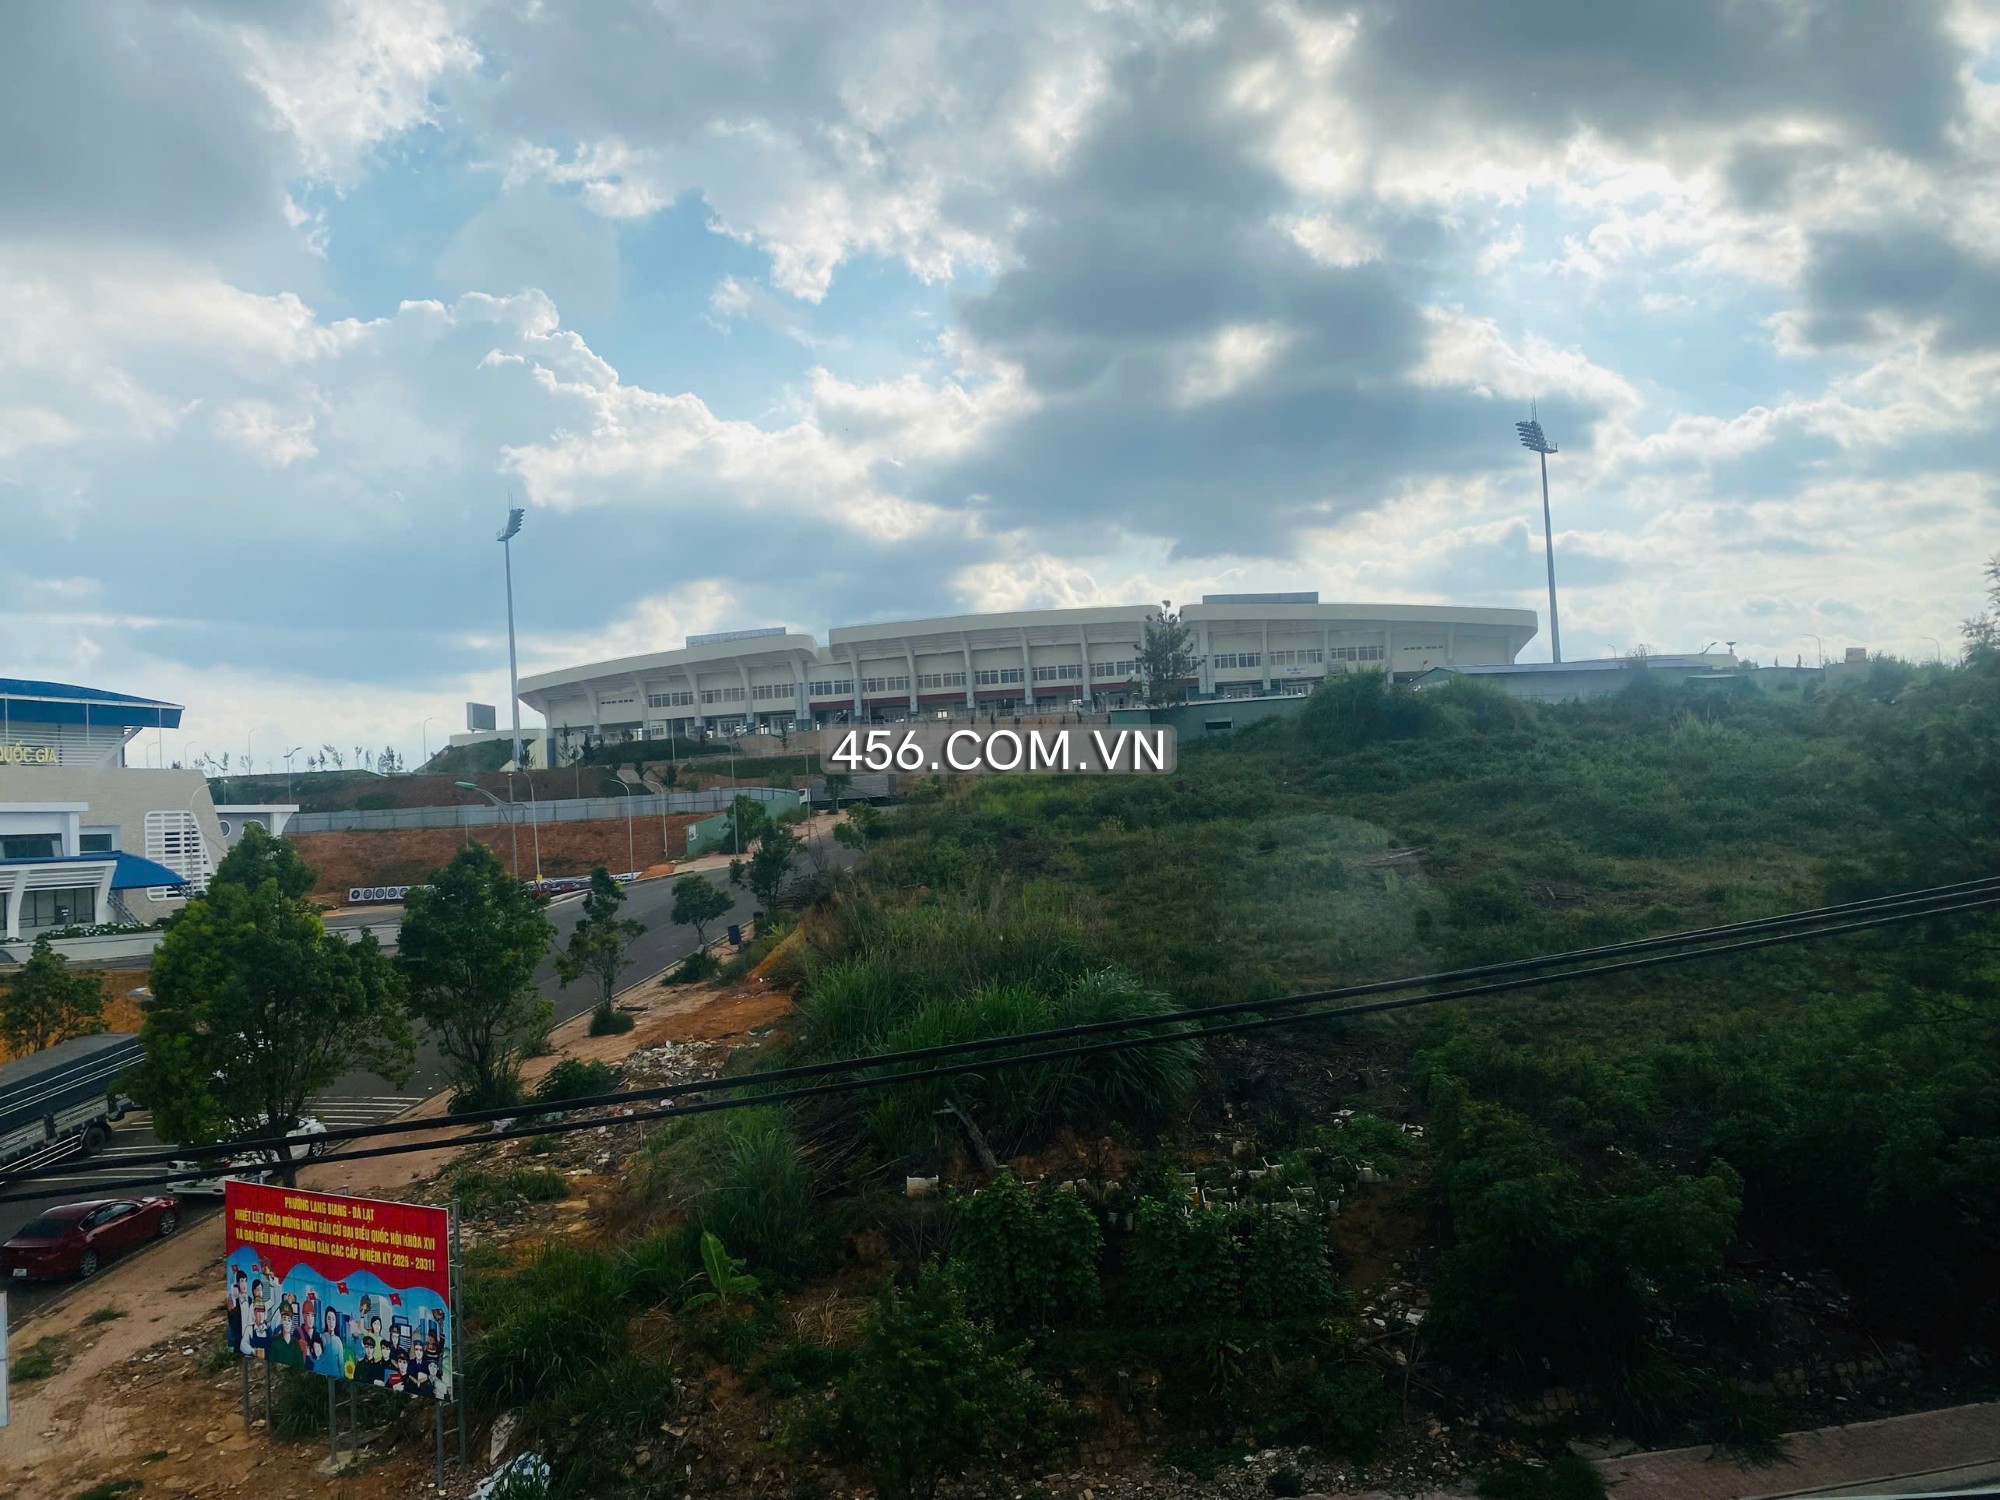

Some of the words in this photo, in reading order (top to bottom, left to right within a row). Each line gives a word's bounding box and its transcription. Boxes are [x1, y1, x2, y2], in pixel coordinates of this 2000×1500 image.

[36, 748, 58, 763] GIA
[310, 1200, 326, 1214] LANG
[327, 1203, 347, 1217] BIANG
[362, 1208, 374, 1223] LẠT
[252, 1210, 264, 1226] LIỆT
[265, 1212, 281, 1227] CHÀO
[301, 1218, 317, 1232] NGÀY
[371, 1227, 389, 1244] QUỐC
[390, 1230, 402, 1248] HỘI
[423, 1237, 435, 1251] XVI
[235, 1226, 244, 1240] VÀ
[269, 1232, 280, 1248] HỘI
[331, 1242, 344, 1257] CÁC
[345, 1243, 358, 1259] CẤP
[359, 1248, 381, 1265] NHIỆM
[392, 1254, 409, 1268] 2026
